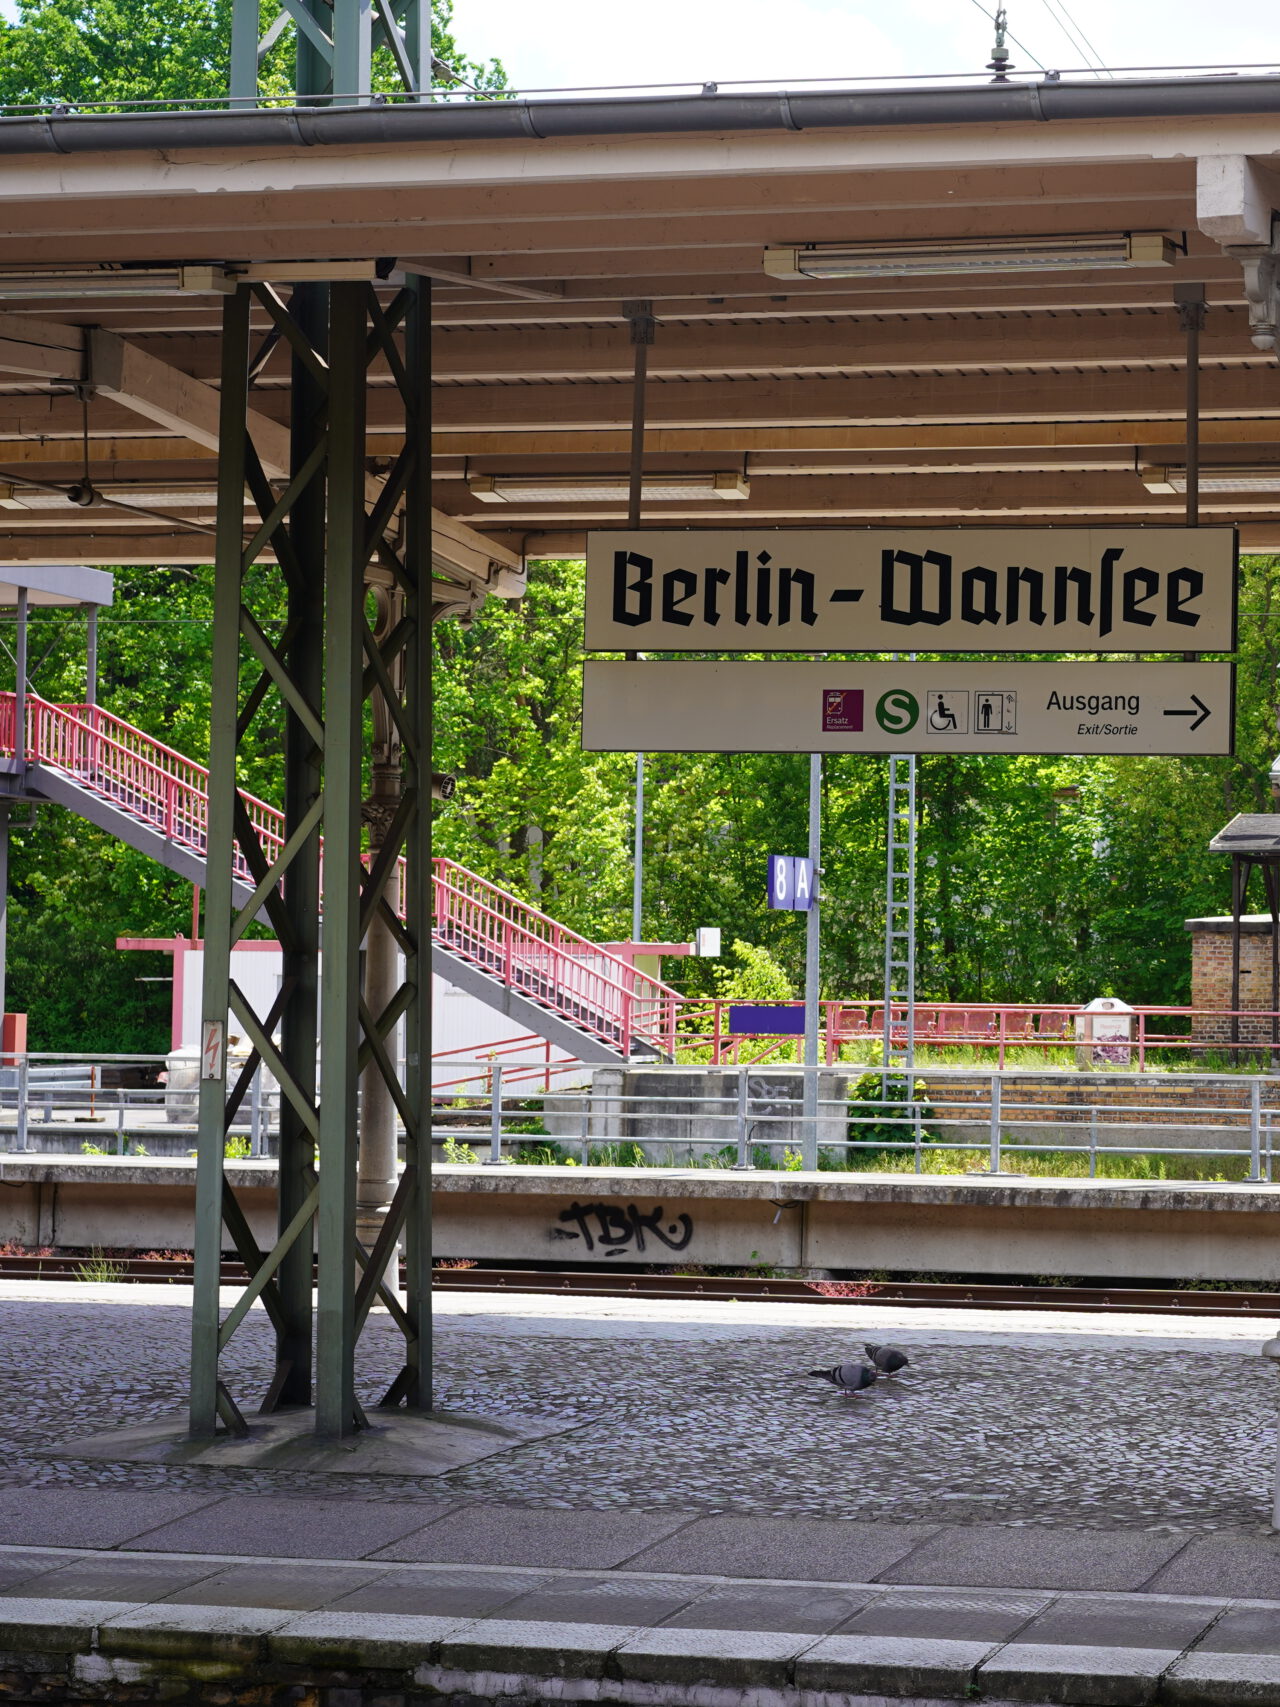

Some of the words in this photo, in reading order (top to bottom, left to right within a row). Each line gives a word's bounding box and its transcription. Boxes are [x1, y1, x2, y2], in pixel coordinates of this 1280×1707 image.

[884, 694, 911, 729] S
[1046, 690, 1140, 715] Ausgang
[826, 716, 849, 724] Ersatz
[1077, 723, 1138, 736] Exit/Sortie
[776, 858, 787, 900] 8
[797, 860, 809, 899] A
